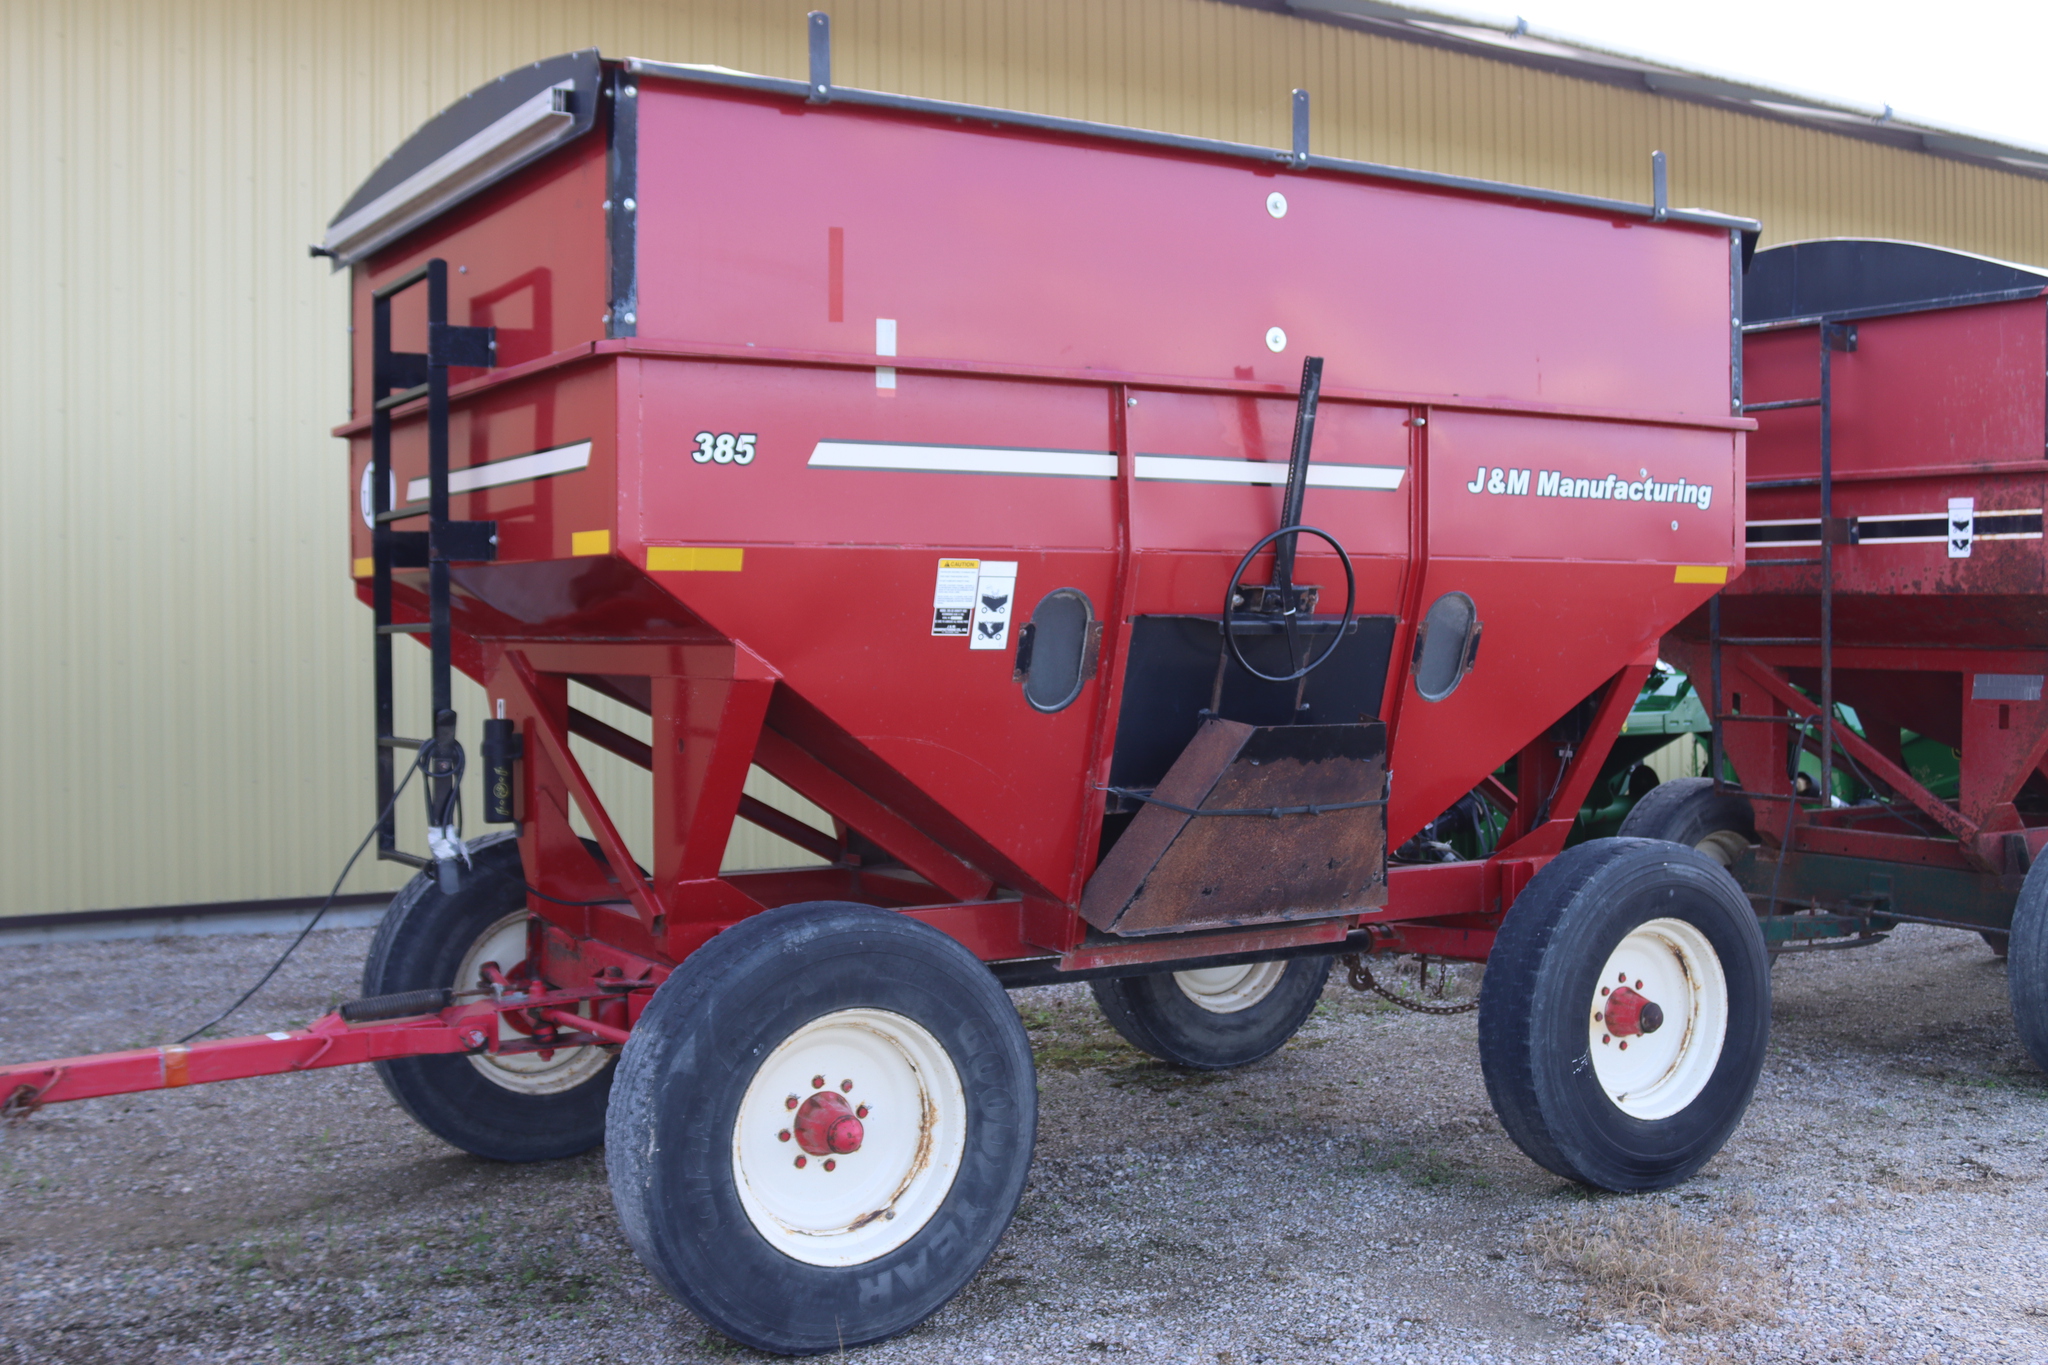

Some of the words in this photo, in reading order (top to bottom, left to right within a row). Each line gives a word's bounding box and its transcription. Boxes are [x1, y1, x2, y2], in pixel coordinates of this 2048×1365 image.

[691, 431, 757, 465] 385
[1467, 466, 1531, 496] J&M
[1536, 470, 1713, 510] Manufacturing
